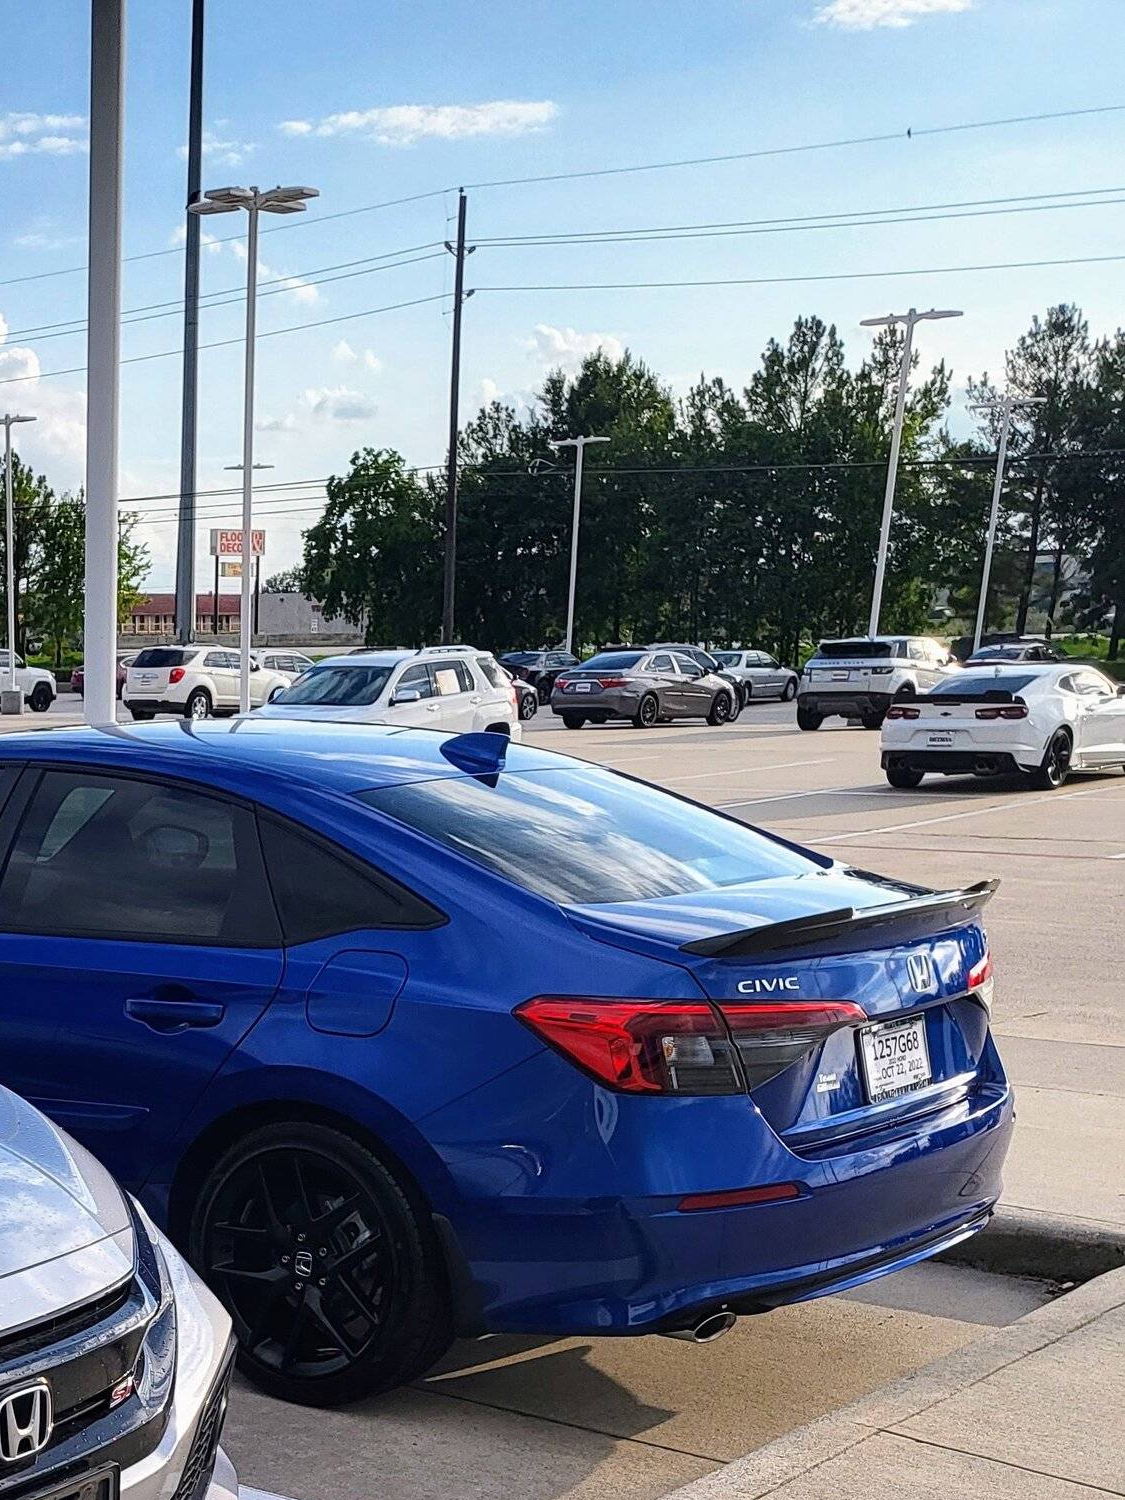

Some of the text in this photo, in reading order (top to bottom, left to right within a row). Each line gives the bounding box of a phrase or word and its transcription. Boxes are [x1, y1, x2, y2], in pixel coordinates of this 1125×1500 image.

[220, 532, 243, 542] FLOO
[220, 543, 243, 553] DECO
[737, 976, 800, 994] CIVIC
[872, 1031, 919, 1061] 1257G68
[881, 1058, 924, 1080] OCT 22, 2022
